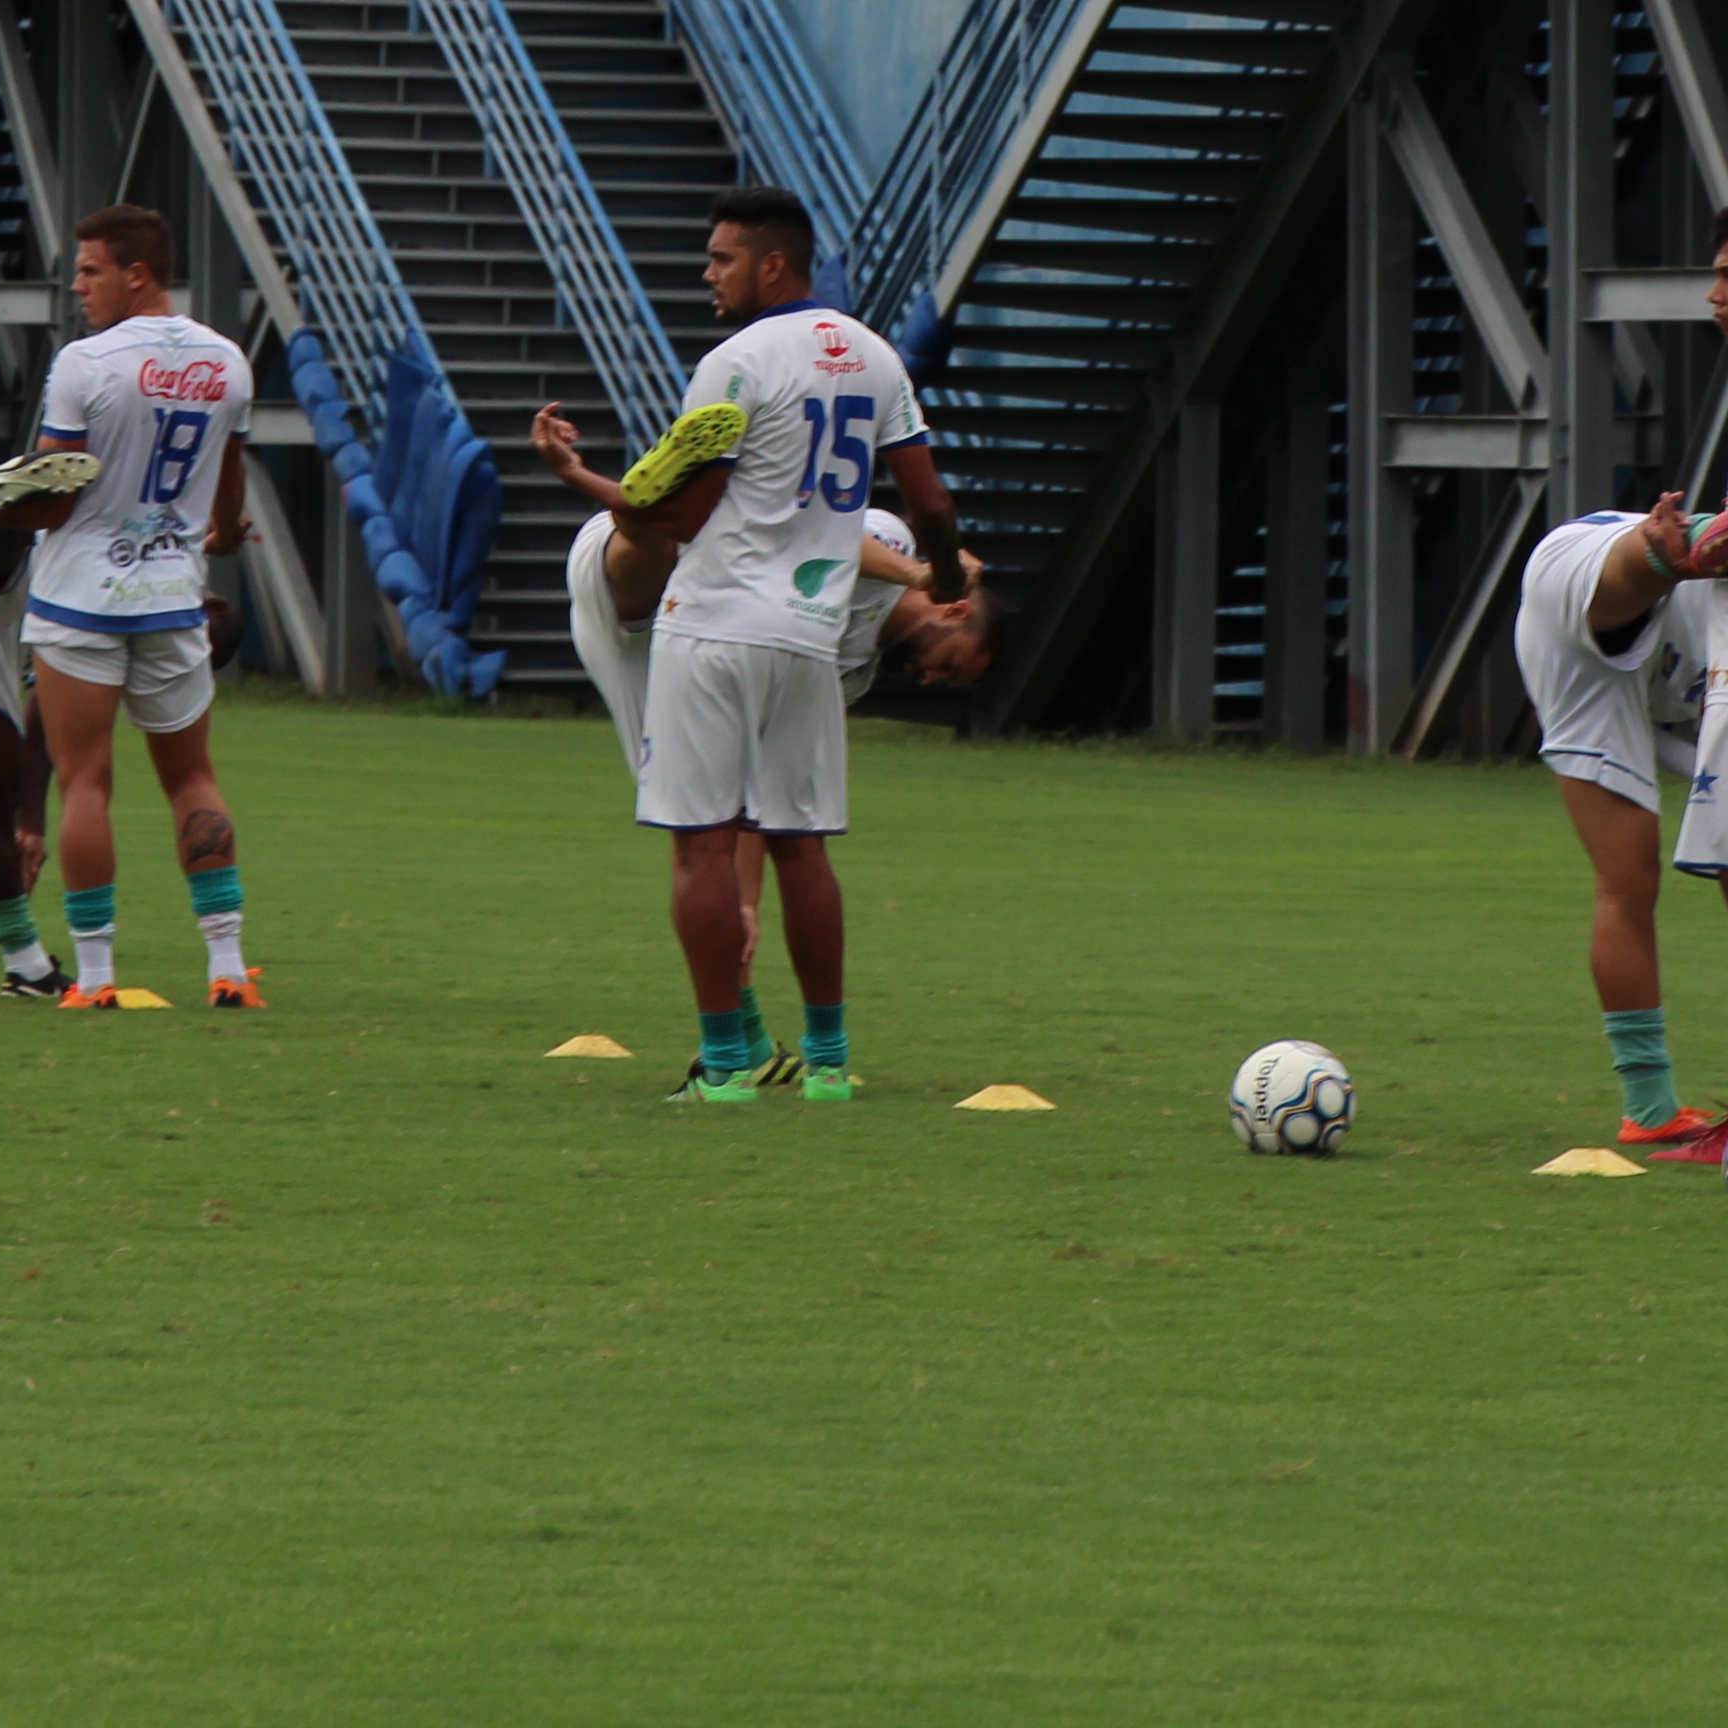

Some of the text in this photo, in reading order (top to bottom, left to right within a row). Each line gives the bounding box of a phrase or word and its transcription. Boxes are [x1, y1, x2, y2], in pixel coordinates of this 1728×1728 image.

[139, 407, 211, 504] 18
[797, 395, 876, 513] 15
[1253, 1057, 1281, 1123] Topper
